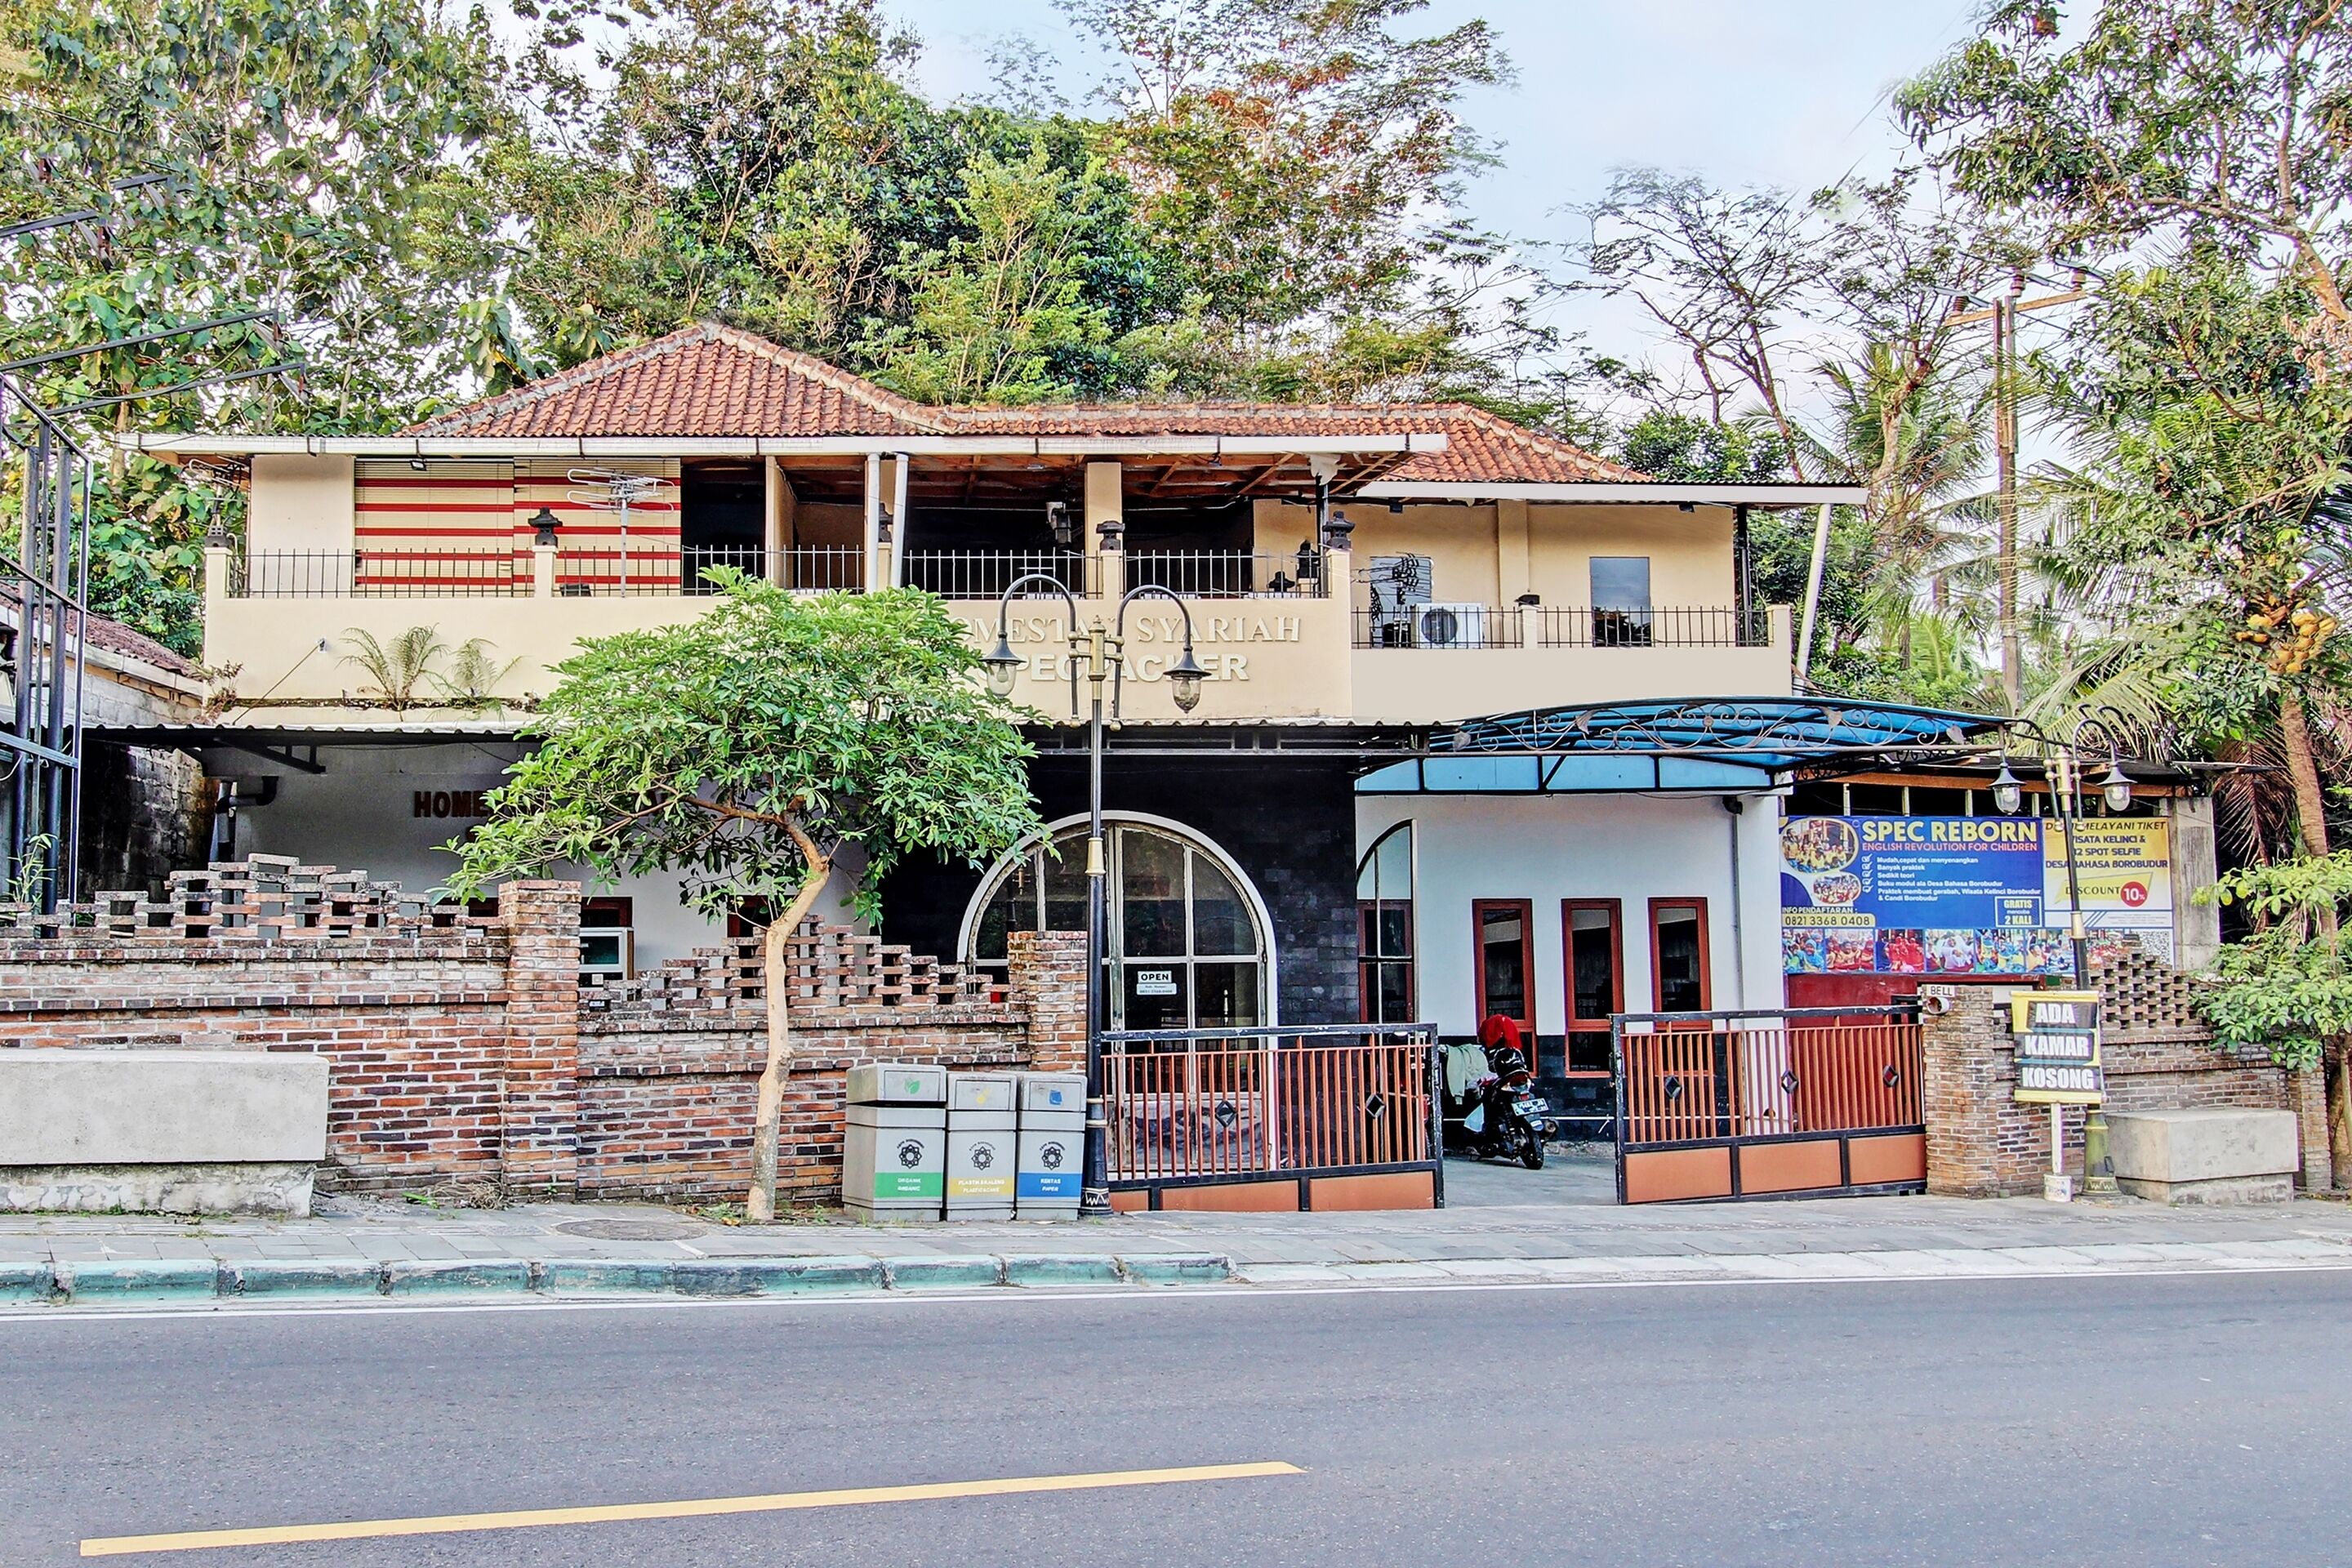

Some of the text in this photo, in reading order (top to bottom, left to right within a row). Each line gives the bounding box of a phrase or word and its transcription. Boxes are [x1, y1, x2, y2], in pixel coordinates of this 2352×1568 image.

[949, 617, 1301, 643] OMESTA SYARIAH
[2138, 822, 2166, 830] TIKET
[1862, 821, 1925, 842] SPEC
[1931, 822, 2038, 842] REBORN
[1862, 843, 2038, 851] ENGLISH REVOLUTION FOR CHILDREN
[2065, 886, 2121, 895] DSCOUNT
[2003, 899, 2033, 909] GRATIS
[1785, 916, 1869, 925] 0821 3368 0408
[2005, 915, 2032, 924] 2 KALI
[1931, 986, 1953, 996] BELL
[2036, 1004, 2075, 1023] ADA
[2025, 1036, 2089, 1057] KAMAR
[2022, 1067, 2094, 1089] KOSONG
